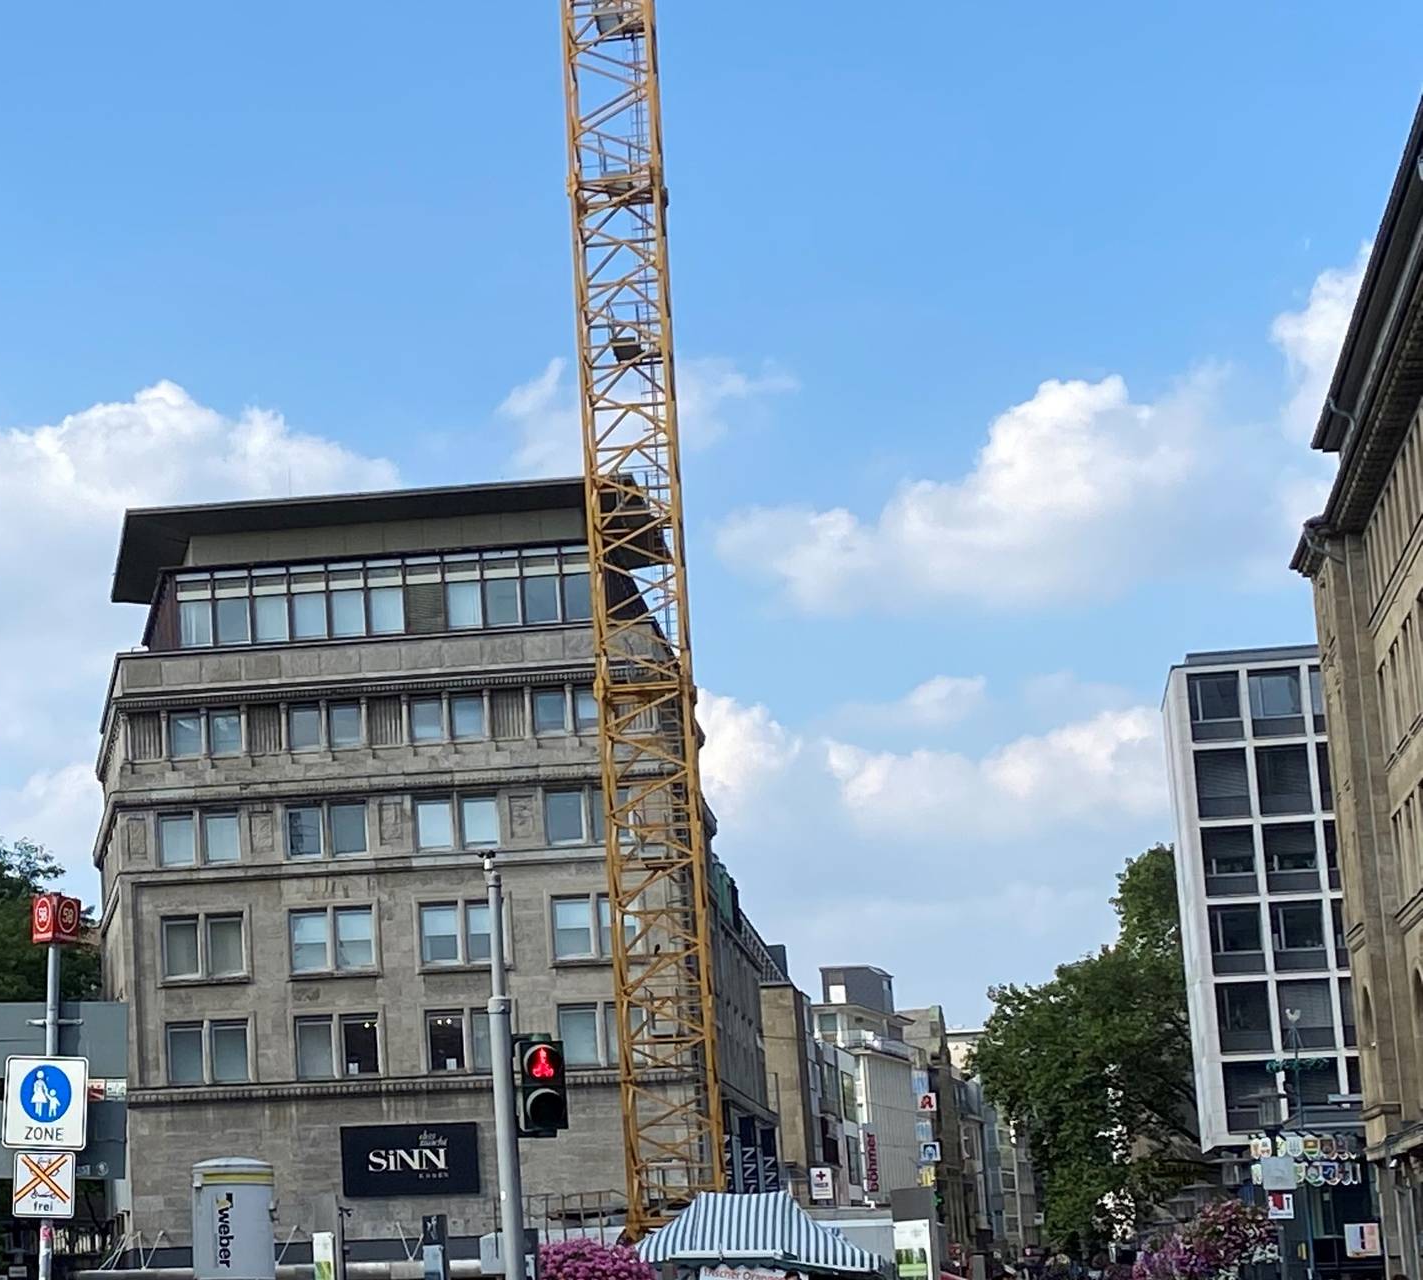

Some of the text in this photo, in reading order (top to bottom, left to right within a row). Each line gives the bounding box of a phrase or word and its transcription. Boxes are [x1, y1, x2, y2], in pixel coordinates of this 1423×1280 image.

[24, 1126, 64, 1142] ZONE
[34, 1201, 53, 1211] frei
[218, 1207, 235, 1268] weber
